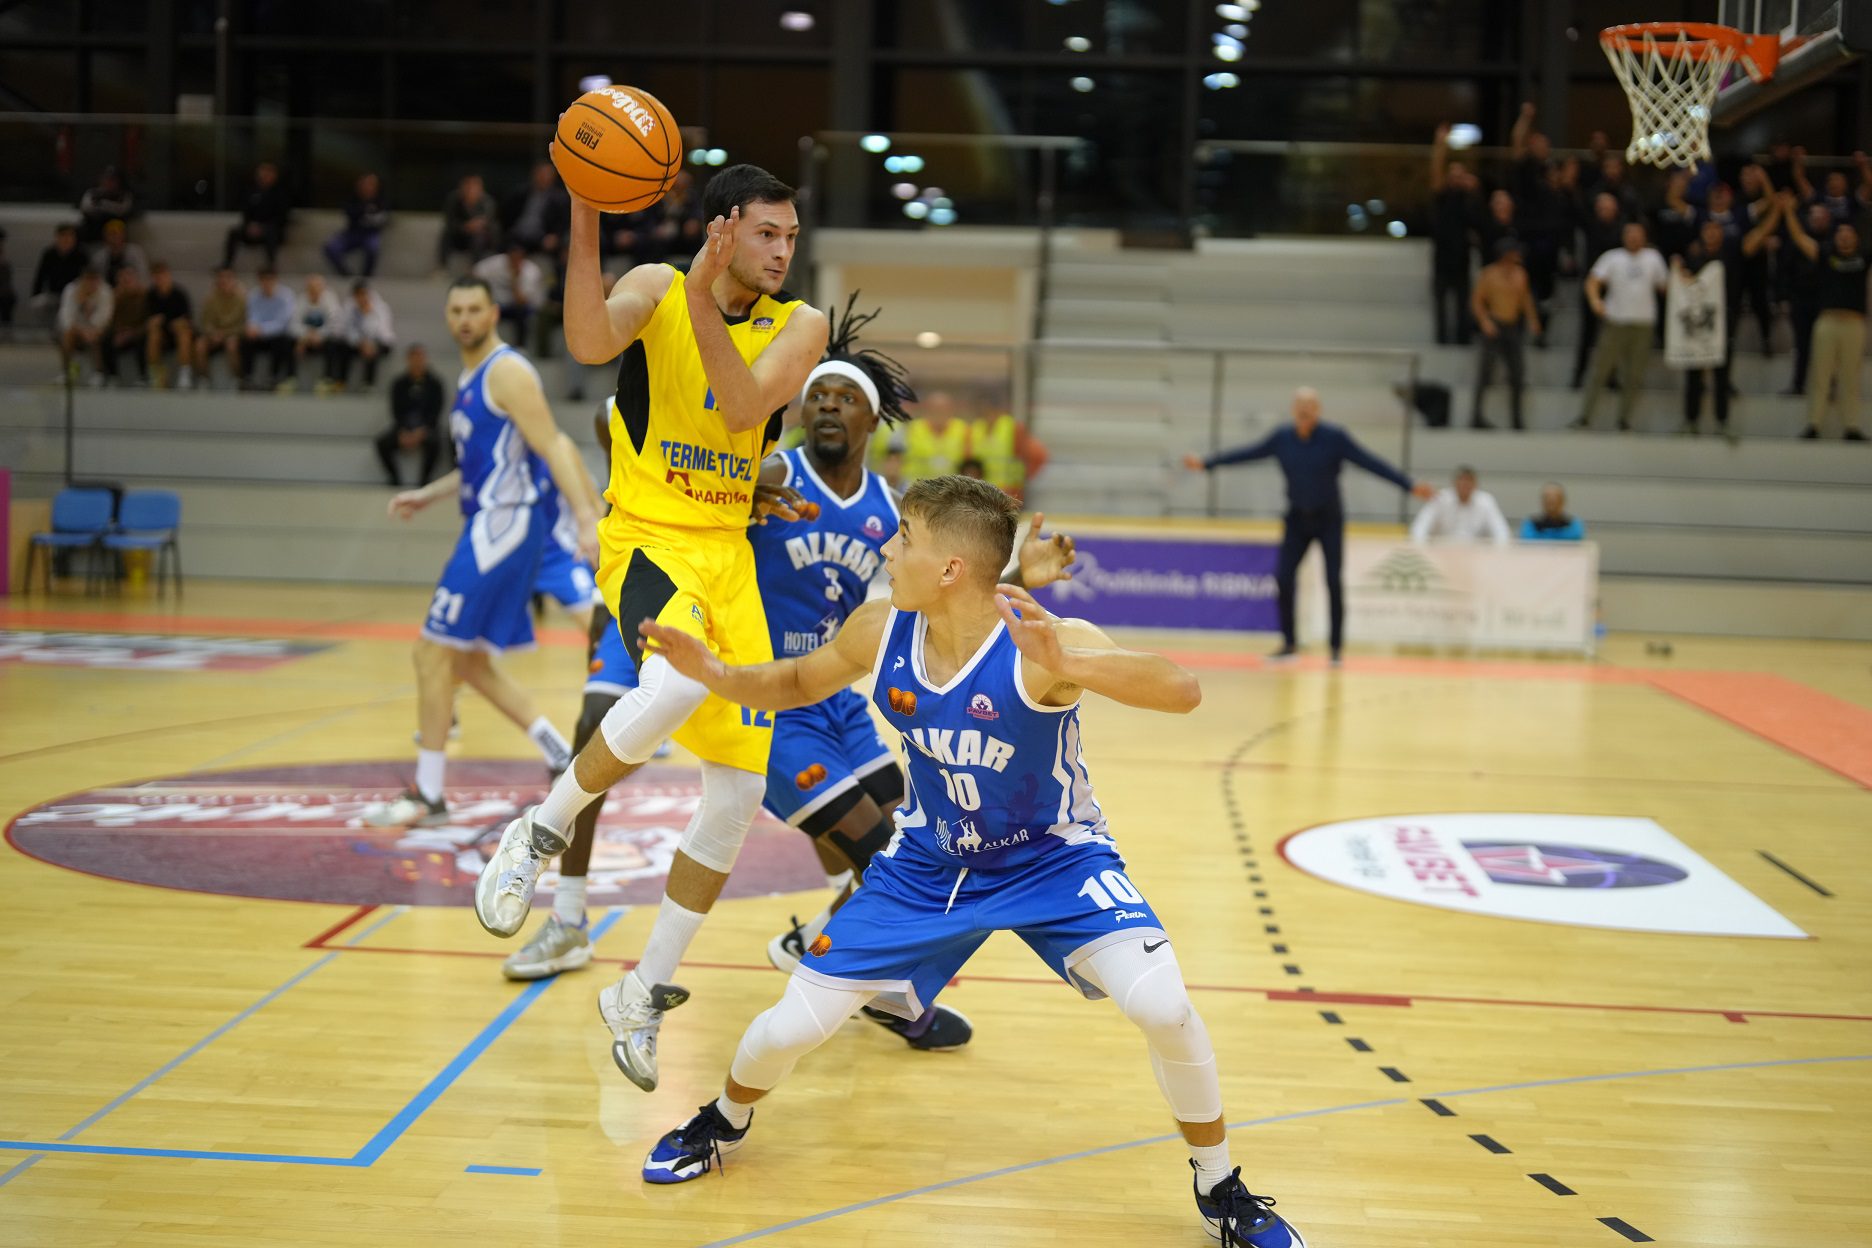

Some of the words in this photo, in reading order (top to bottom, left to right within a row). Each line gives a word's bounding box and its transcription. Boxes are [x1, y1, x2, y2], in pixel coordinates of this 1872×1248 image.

[575, 127, 600, 150] FIBA
[660, 440, 717, 471] TERME
[822, 567, 844, 601] 3
[429, 587, 464, 625] 21
[908, 727, 1016, 774] LKAR
[938, 767, 982, 812] 10
[984, 828, 1030, 850] ALKAR
[1077, 869, 1144, 910] 10
